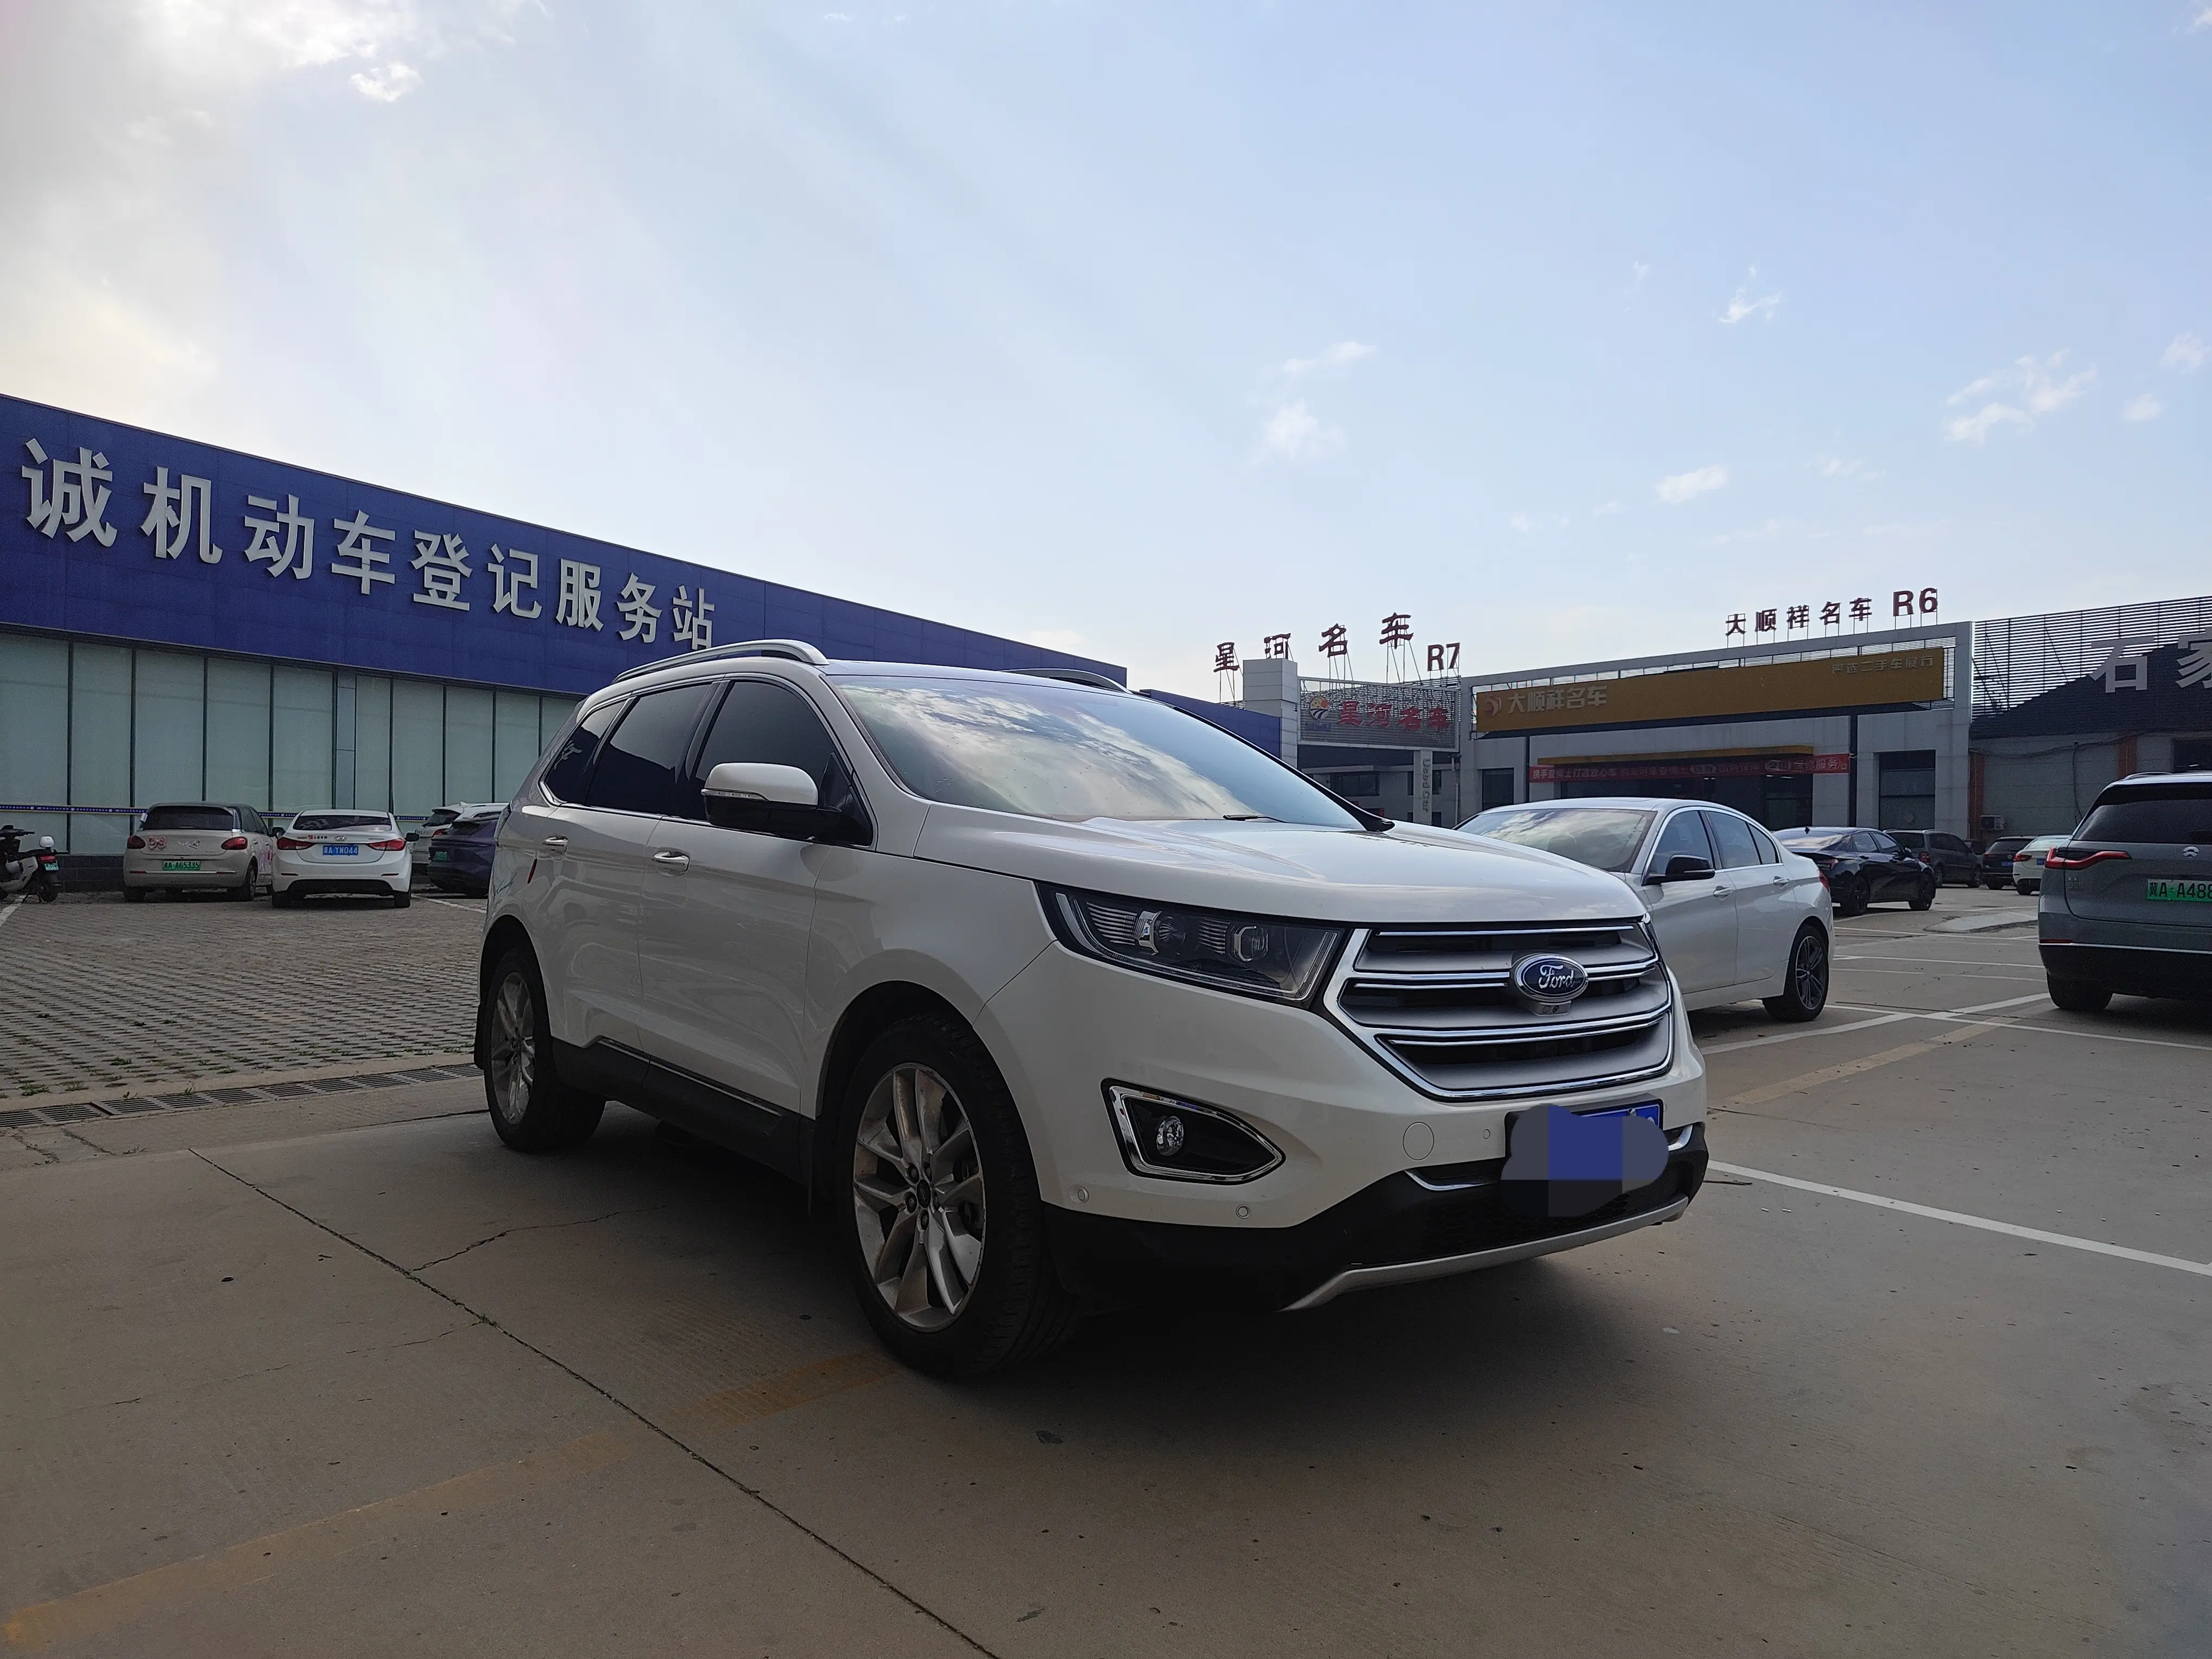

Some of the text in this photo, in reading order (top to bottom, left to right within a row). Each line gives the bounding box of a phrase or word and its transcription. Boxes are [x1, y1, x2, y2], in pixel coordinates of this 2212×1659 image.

[22, 438, 715, 650] 诚机动车登记服务站
[1725, 588, 1938, 636] 大顺祥名车 R6
[1213, 612, 1461, 673] 星河名车 R7
[1507, 685, 1607, 714] 大顺祥名车
[1337, 700, 1451, 732] 星河名车
[1423, 757, 1431, 789] Used
[1538, 964, 1576, 989] Ford
